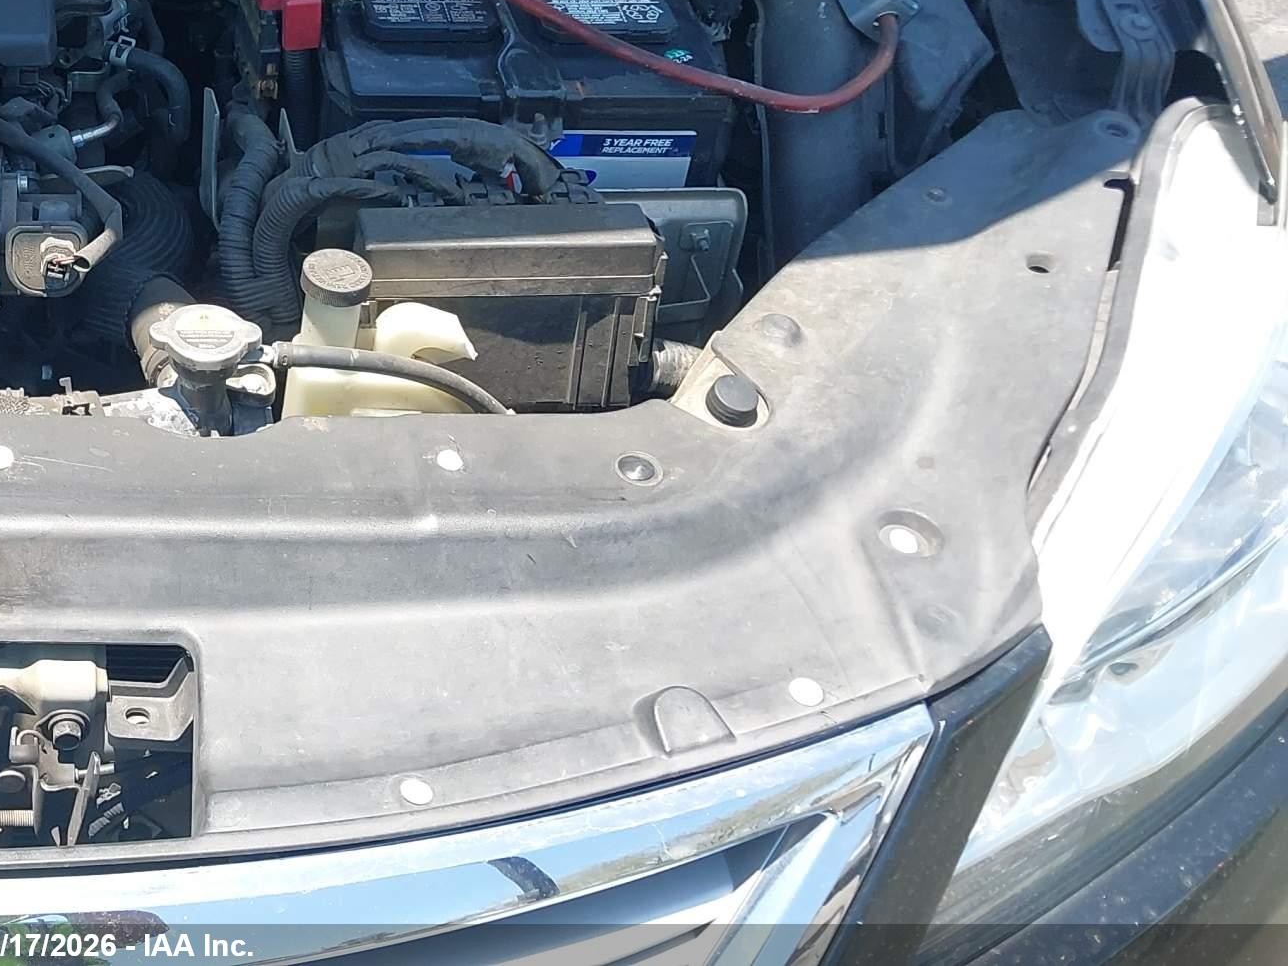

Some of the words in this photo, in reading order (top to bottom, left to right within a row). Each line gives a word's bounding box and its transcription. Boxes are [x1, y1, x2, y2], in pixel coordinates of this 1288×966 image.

[603, 138, 613, 147] 3
[613, 138, 643, 147] YEAR
[643, 138, 674, 147] FREE
